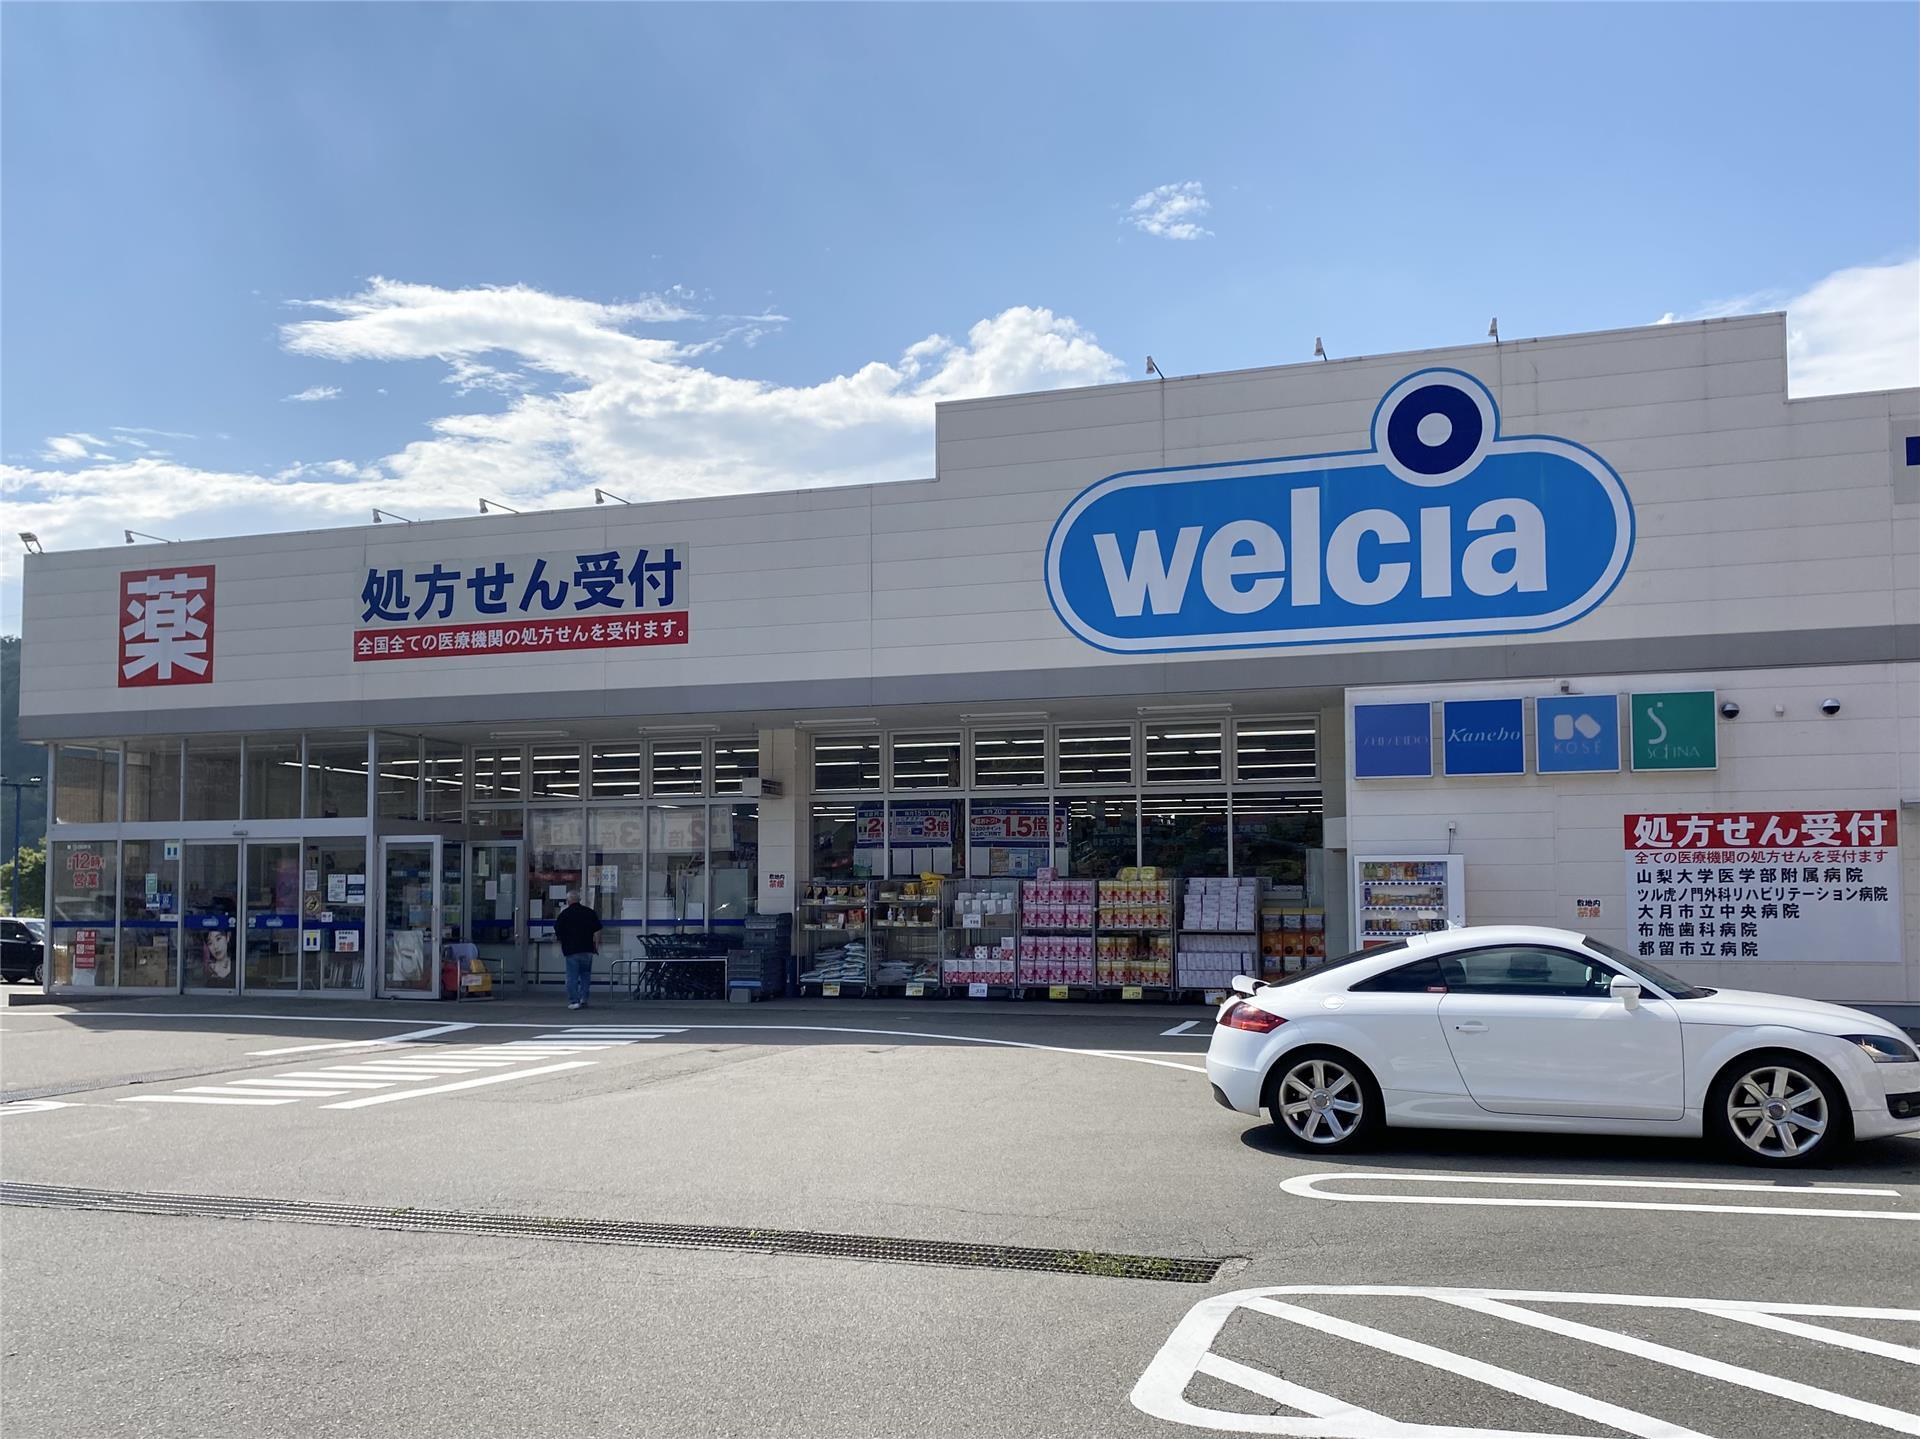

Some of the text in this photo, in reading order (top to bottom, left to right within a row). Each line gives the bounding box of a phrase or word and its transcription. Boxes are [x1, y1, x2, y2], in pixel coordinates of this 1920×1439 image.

[1094, 487, 1548, 618] welcia
[361, 548, 682, 624] 処方せん受付
[122, 573, 209, 680] 薬
[358, 619, 684, 655] 全国全ての医療機関の処方せんを受付ます。
[1448, 727, 1521, 743] Kanebo
[924, 817, 949, 832] 3倍
[1634, 813, 1888, 848] 処方せん受付
[1635, 850, 1888, 864] 全ての医療機関の処方せんを受付ます
[1637, 867, 1863, 884] 山梨大学医学部附属病院
[1638, 886, 1888, 902] ツル虎ノ門外科リハビリテーション病院
[1638, 903, 1800, 919] 大月市立中央病院
[1638, 922, 1758, 937] 布施歯科病院
[1638, 941, 1758, 956] 都留市立病院
